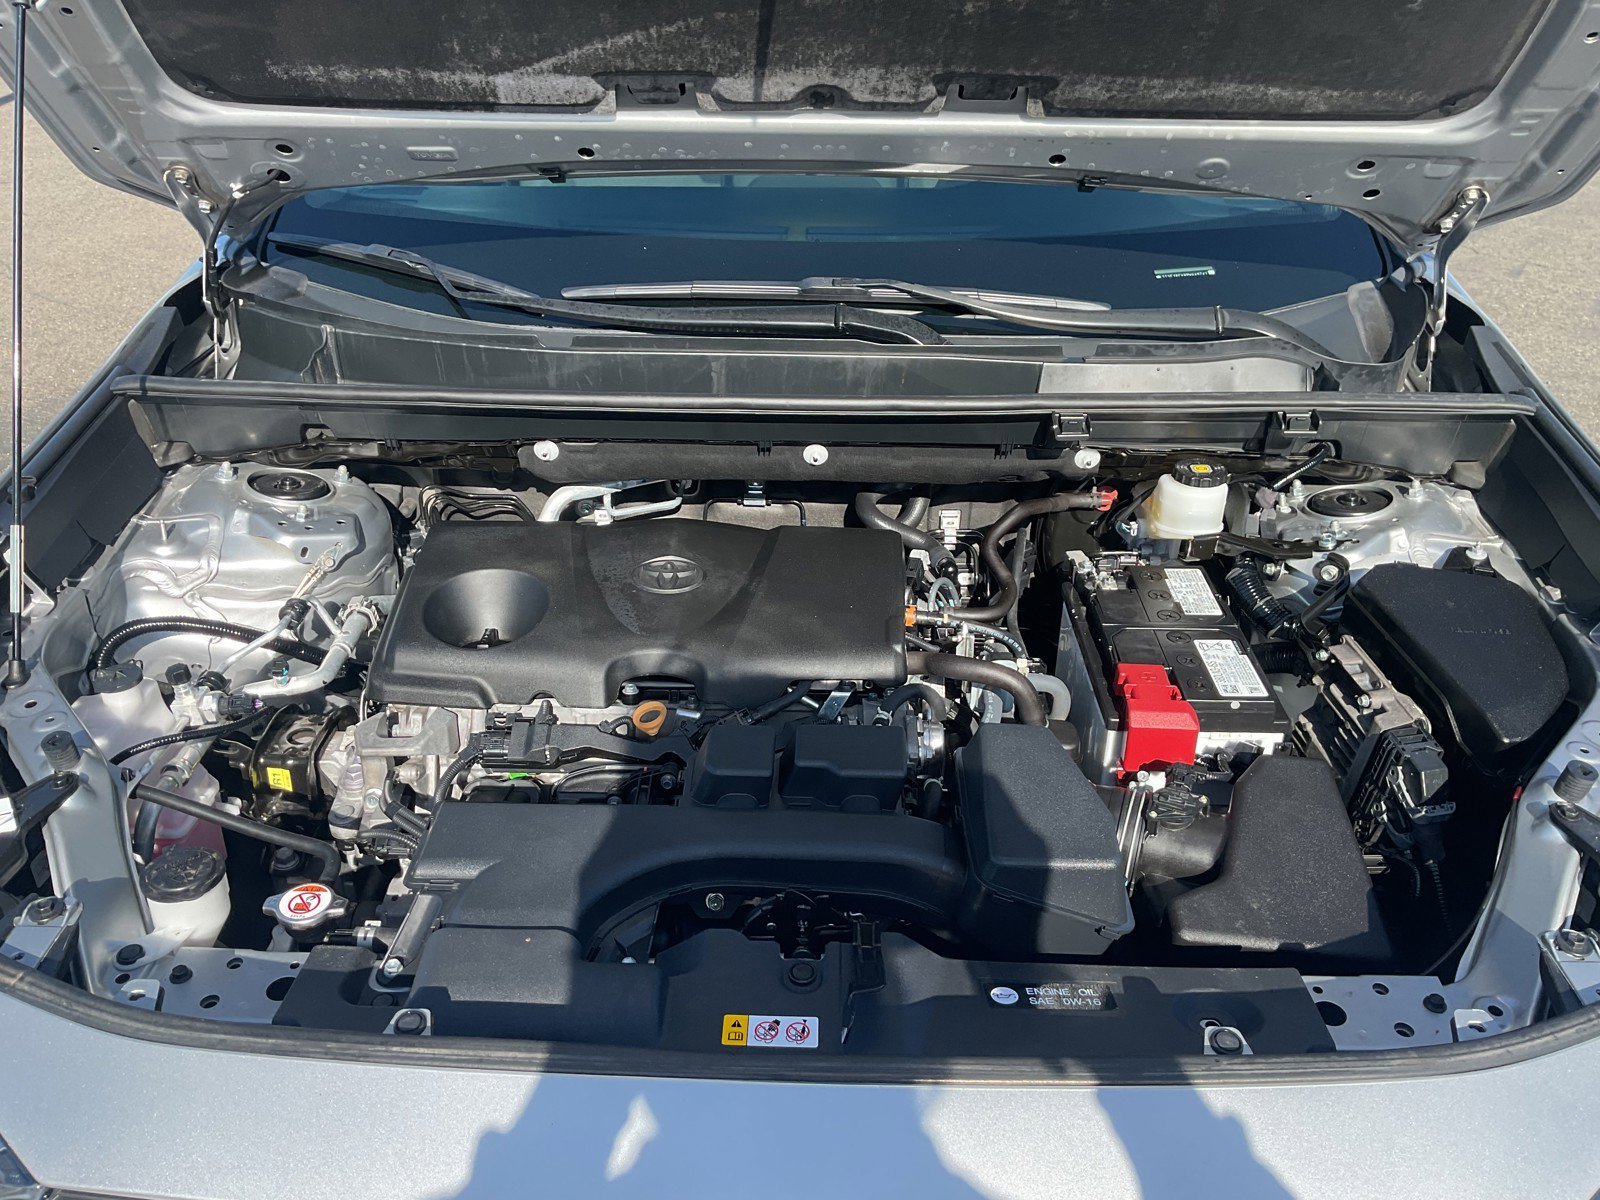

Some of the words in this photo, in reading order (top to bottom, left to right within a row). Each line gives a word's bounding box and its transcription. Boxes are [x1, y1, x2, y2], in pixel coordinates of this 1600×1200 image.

[1025, 987, 1071, 996] ENGINE
[1078, 988, 1099, 997] OIL
[1029, 997, 1055, 1005] SAE
[1062, 998, 1102, 1006] 0W-16
